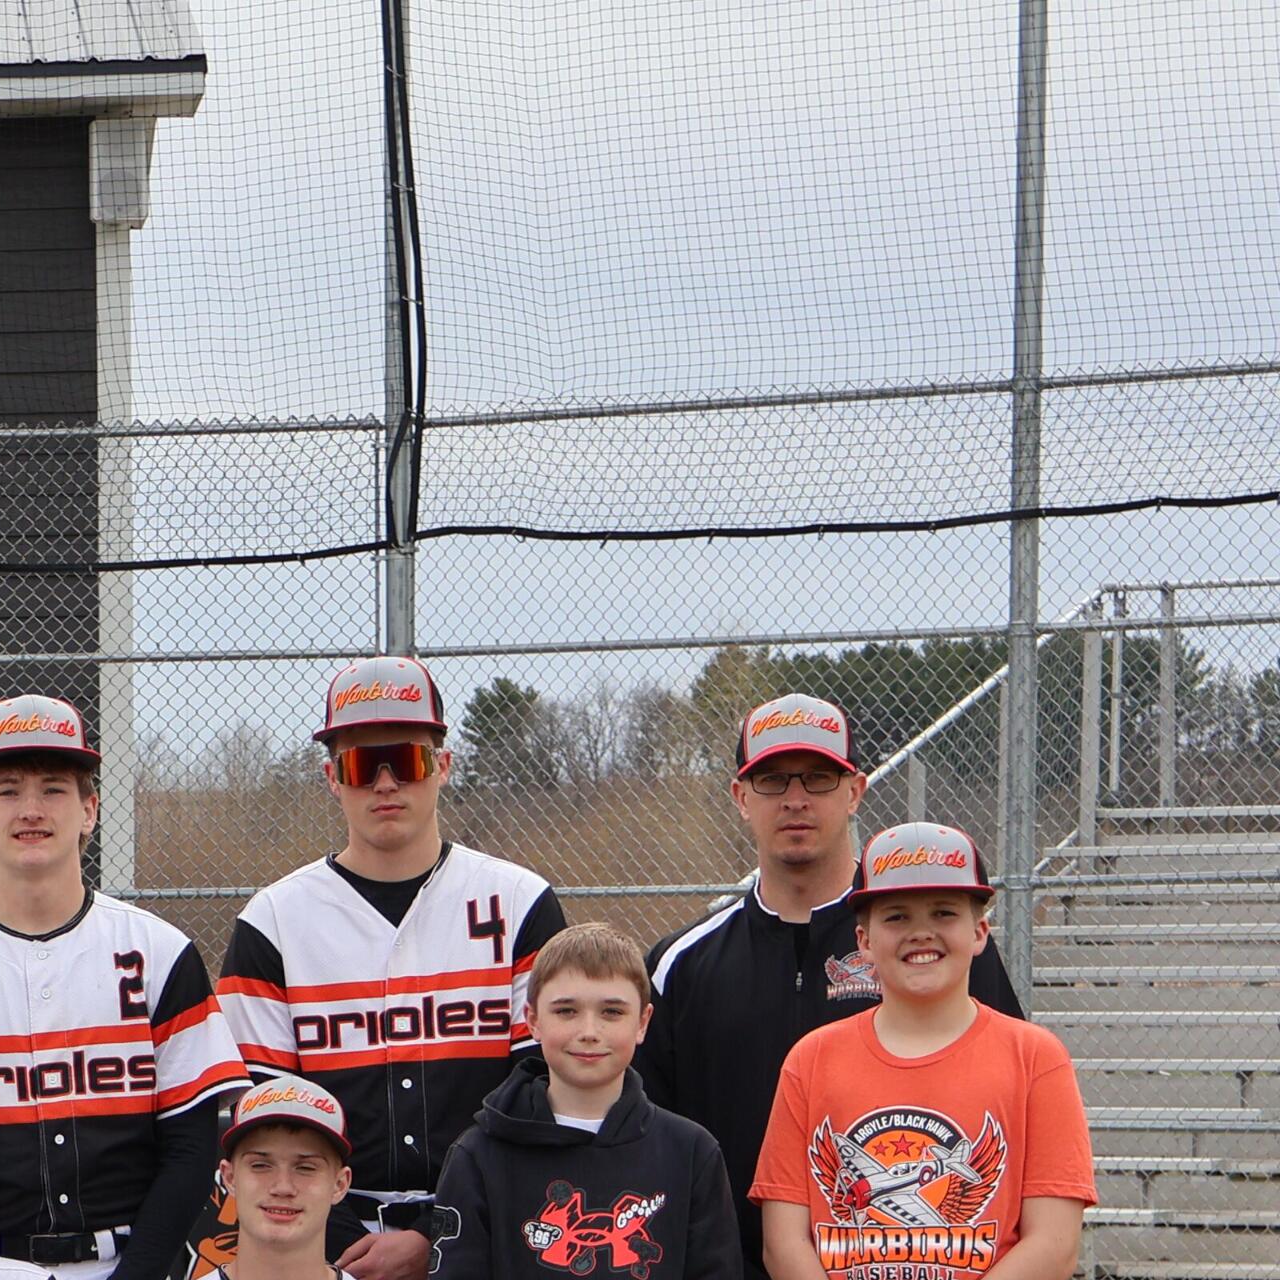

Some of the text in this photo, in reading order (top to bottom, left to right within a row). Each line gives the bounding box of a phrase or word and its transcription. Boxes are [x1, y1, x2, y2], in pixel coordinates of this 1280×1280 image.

[334, 680, 422, 710] Warbirds
[751, 709, 841, 737] Warbirds
[873, 845, 966, 875] Warbirds
[467, 894, 506, 963] 4
[113, 950, 148, 1020] 2
[292, 996, 510, 1050] orioles
[243, 1088, 337, 1113] Warbirds
[853, 1113, 955, 1144] ARGYLE/BLACK HAWK
[816, 1221, 998, 1275] WARBIRDS
